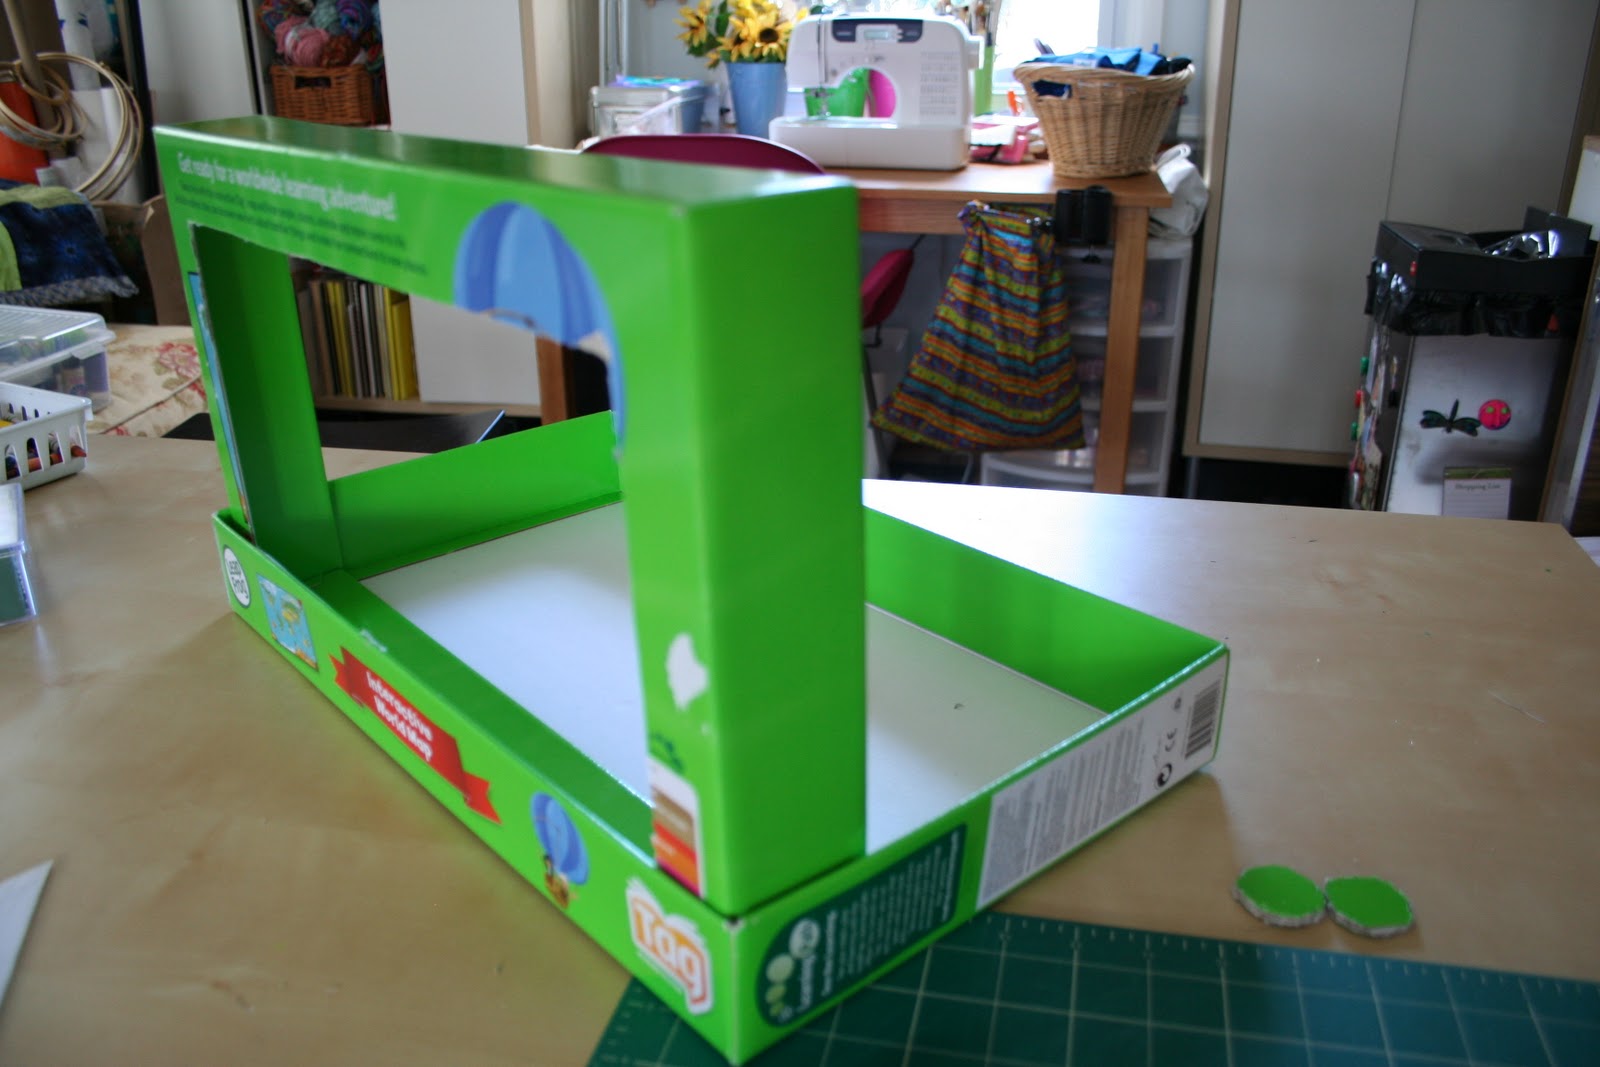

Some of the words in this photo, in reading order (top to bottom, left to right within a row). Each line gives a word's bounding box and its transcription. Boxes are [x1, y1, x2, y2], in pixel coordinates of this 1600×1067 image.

[178, 152, 192, 174] Get
[366, 671, 433, 741] Interactive
[374, 695, 407, 738] World
[406, 725, 433, 762] Map
[630, 893, 710, 1008] Tag
